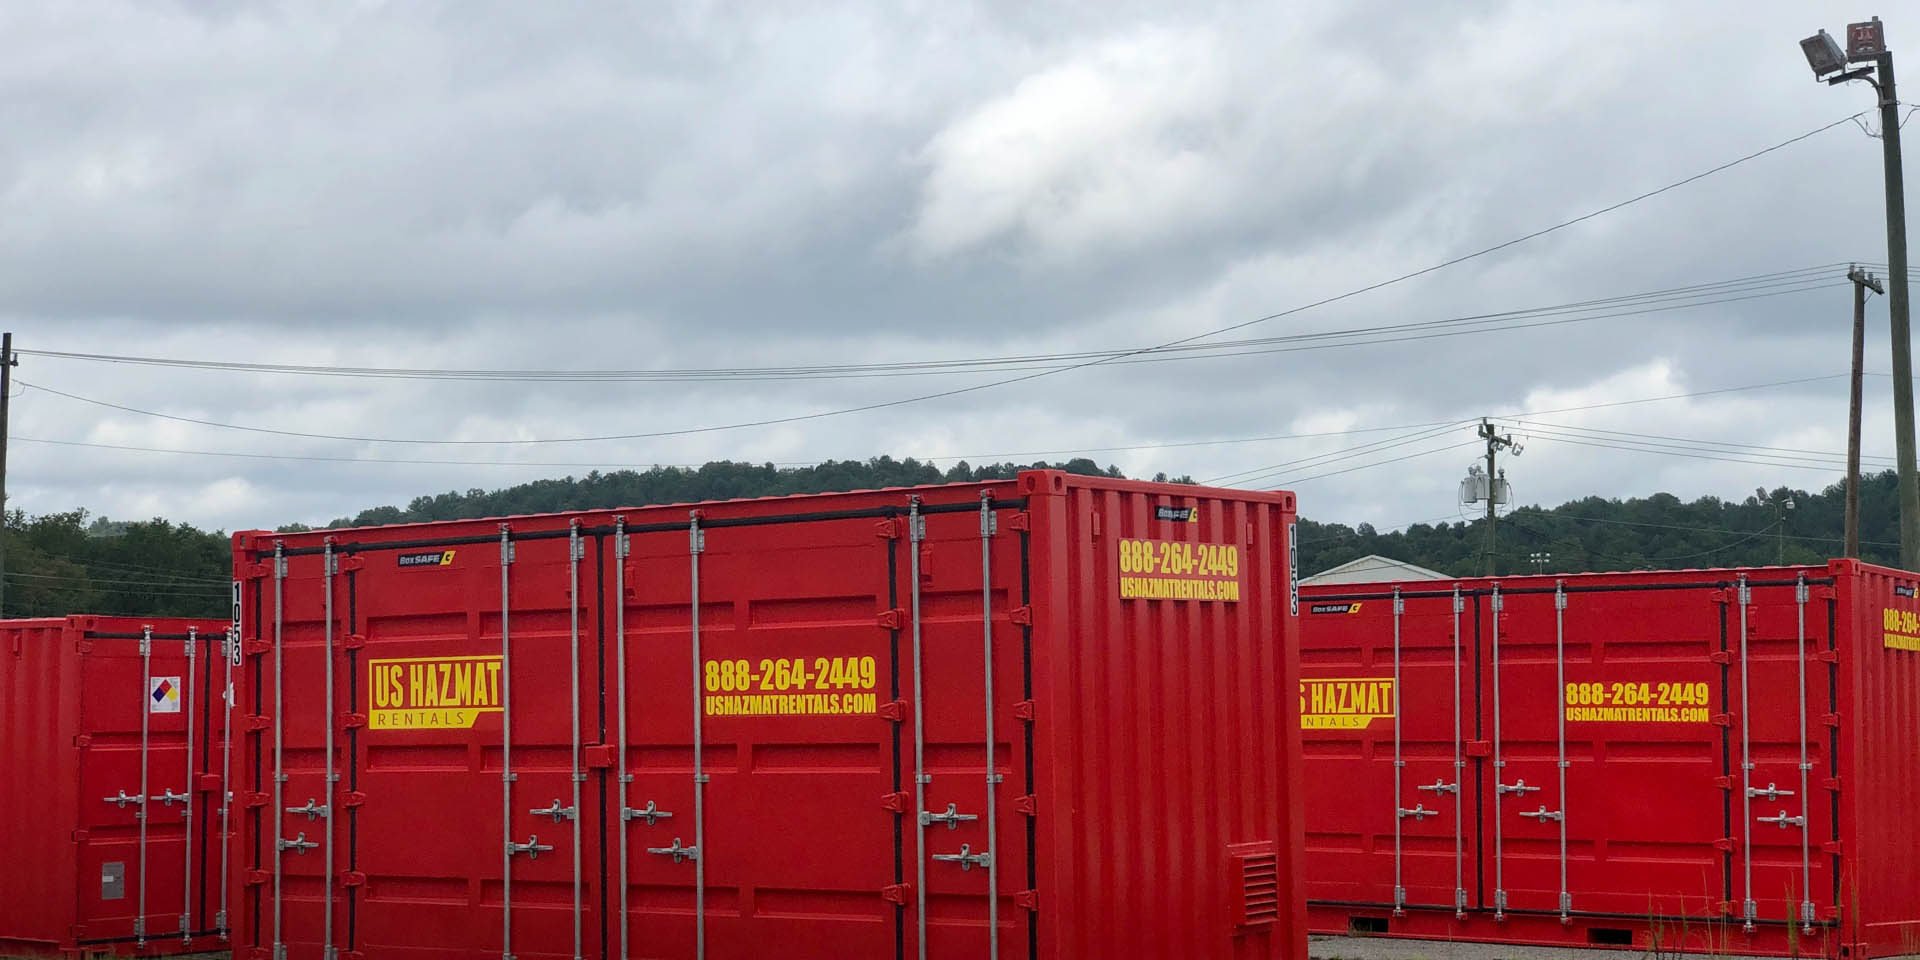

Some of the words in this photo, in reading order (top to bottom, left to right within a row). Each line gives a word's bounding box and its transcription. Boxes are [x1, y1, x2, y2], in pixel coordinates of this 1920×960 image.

[1119, 539, 1239, 577] 888-264-2449
[1119, 576, 1240, 601] USHAZMATRENTALS.COM
[233, 582, 241, 665] 1053
[375, 664, 404, 707] US
[409, 661, 501, 707] HAZMAT
[704, 655, 877, 692] 888-264-2449
[704, 693, 877, 716] USHAZMATRENTALS.COM
[1311, 682, 1392, 714] HAZMAT
[1565, 682, 1710, 705] 888-264-2449
[378, 711, 465, 726] RENTALS
[1306, 716, 1359, 727] NTALS
[1565, 706, 1710, 722] USHAZMATRENTALS.COM
